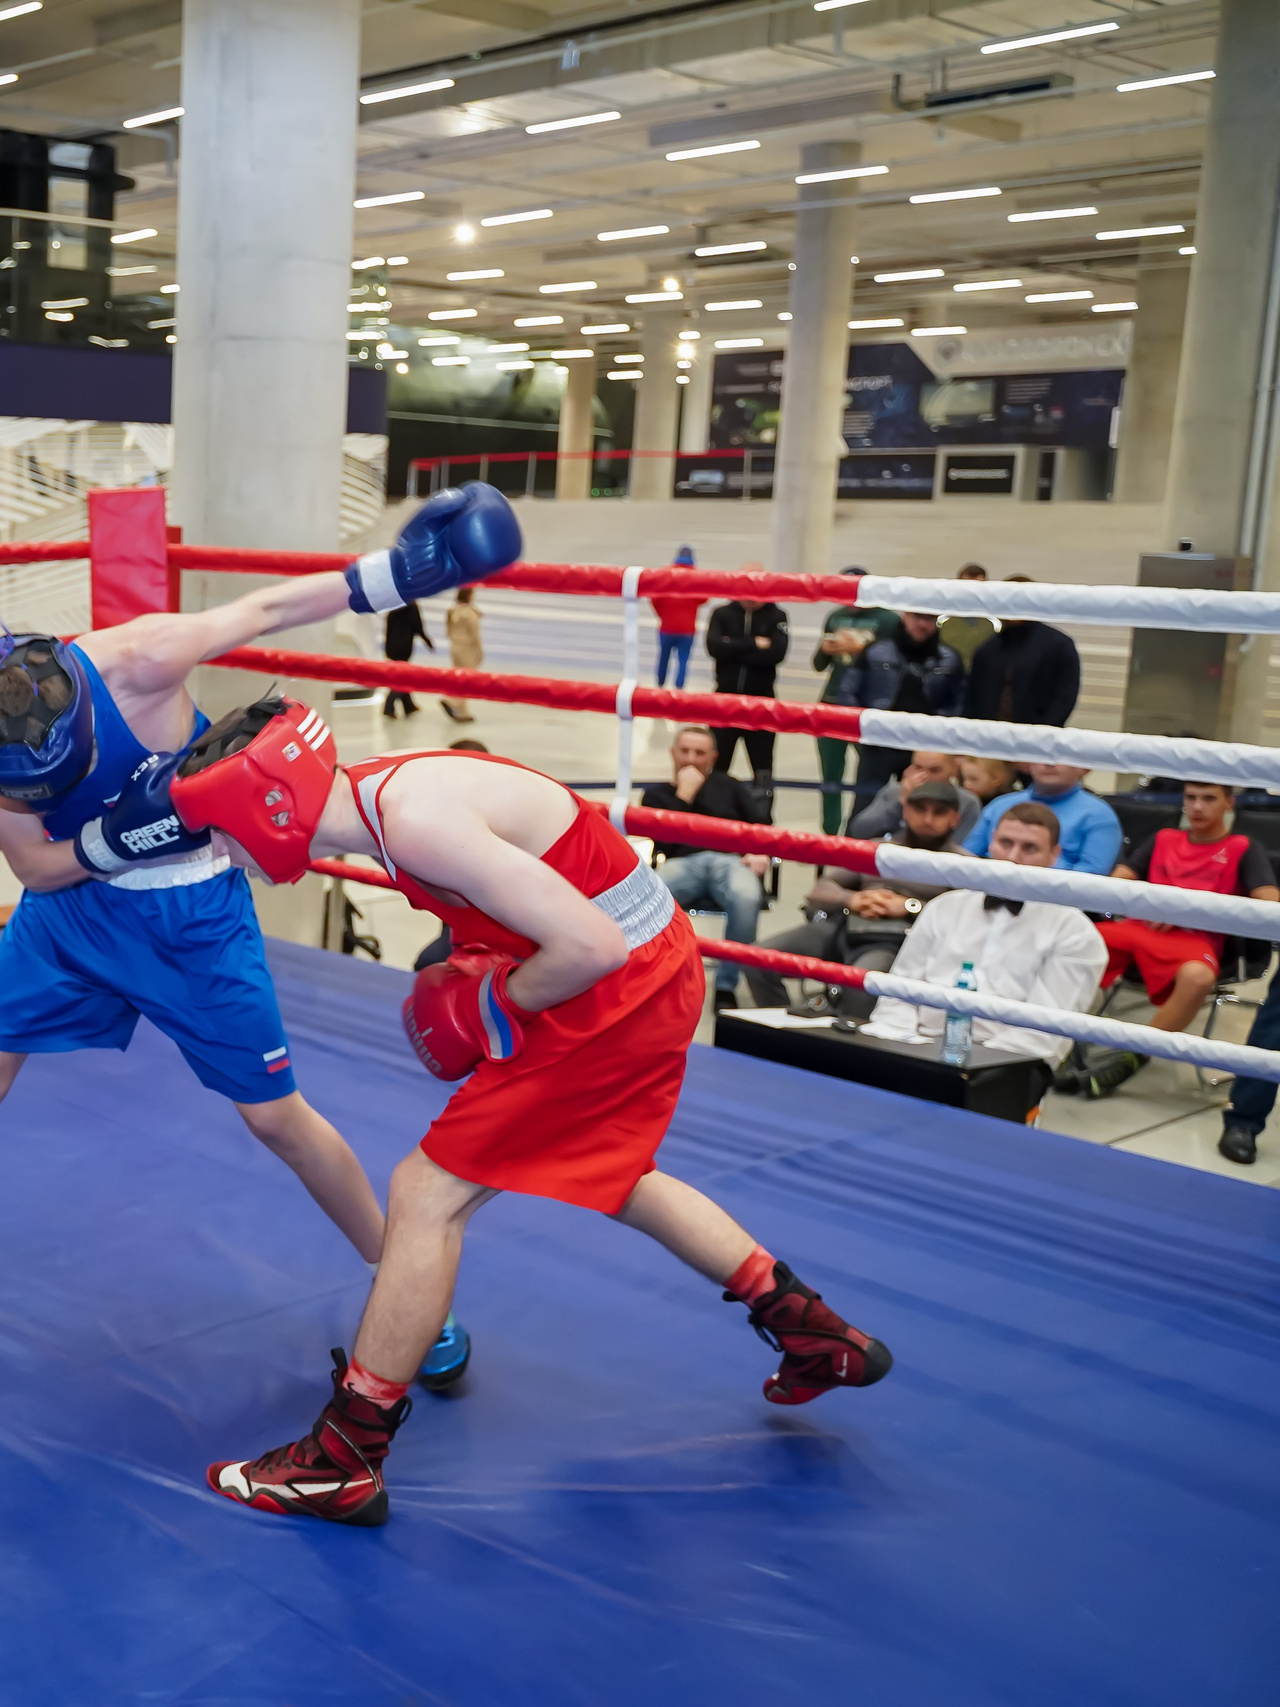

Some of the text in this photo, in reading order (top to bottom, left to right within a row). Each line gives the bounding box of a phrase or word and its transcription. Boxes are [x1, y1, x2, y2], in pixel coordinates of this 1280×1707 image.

[131, 754, 159, 781] REX
[120, 815, 179, 844] GREEN
[127, 831, 179, 853] HILL
